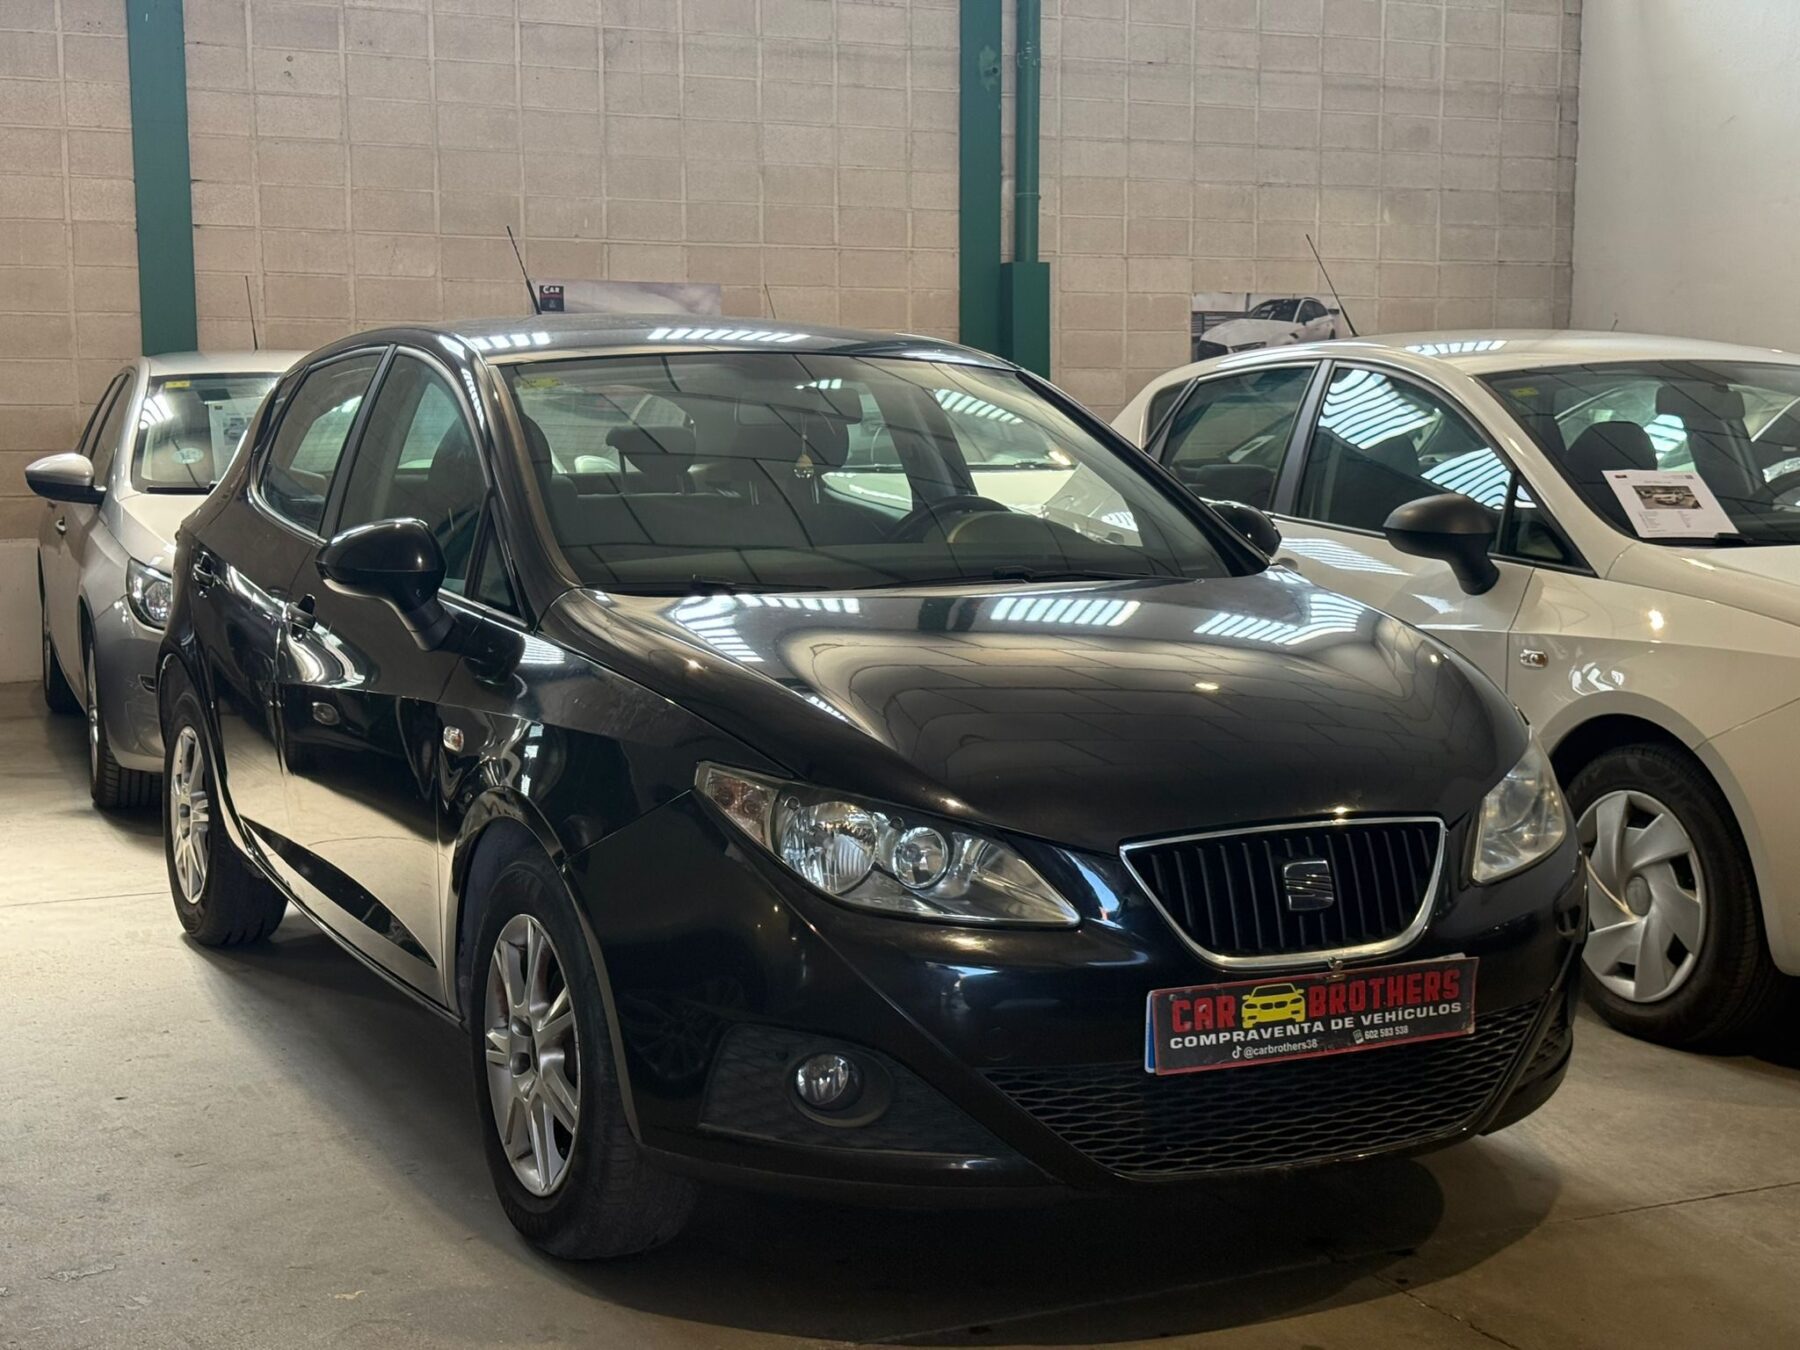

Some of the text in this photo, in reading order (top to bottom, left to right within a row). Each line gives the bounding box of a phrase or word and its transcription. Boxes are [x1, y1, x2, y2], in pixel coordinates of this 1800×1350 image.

[1171, 969, 1461, 1033] CAR BROTHERS
[1170, 1002, 1462, 1050] COMPRAVENTA DE VEHÍCULOS
[1243, 1038, 1318, 1059] @carbrothers38
